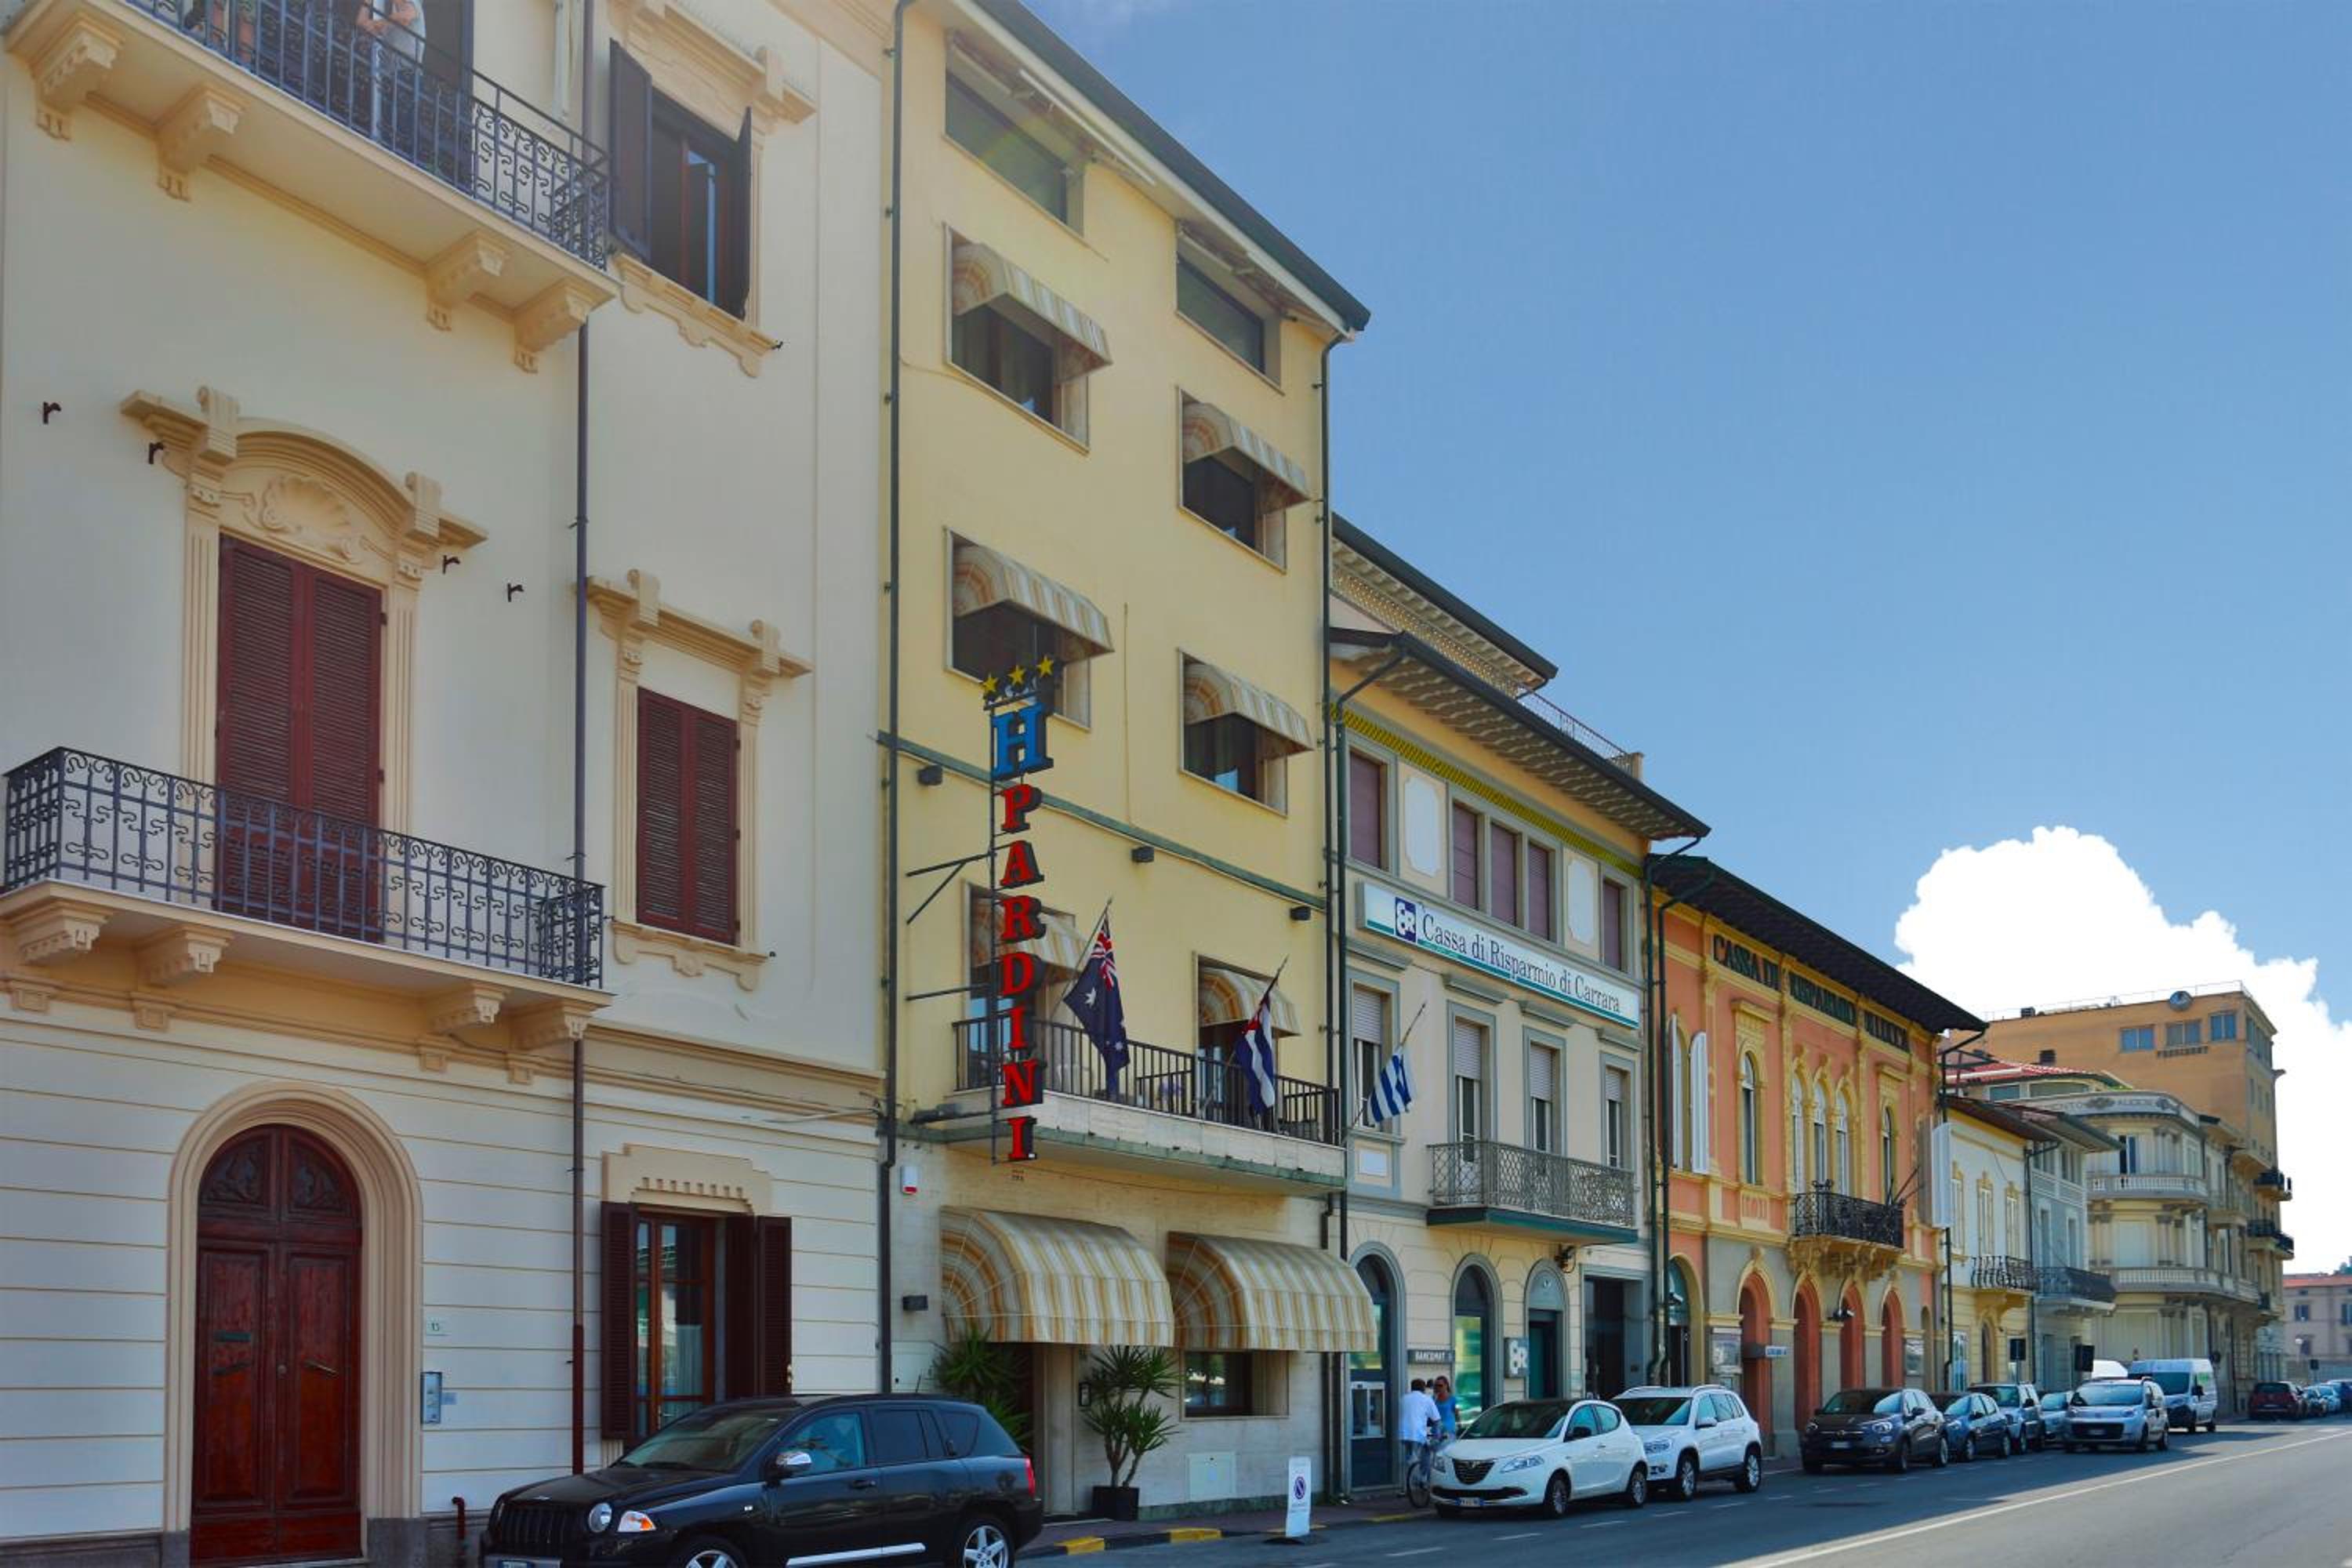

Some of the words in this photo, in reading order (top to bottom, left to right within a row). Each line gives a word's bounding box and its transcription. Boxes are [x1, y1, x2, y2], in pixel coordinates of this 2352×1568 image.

[990, 702, 1052, 780] H
[1000, 783, 1044, 1160] PARDINI
[1423, 913, 1467, 955] Cassa
[1472, 934, 1485, 962] di
[1490, 940, 1556, 989] Risparmio
[1559, 969, 1571, 995] di
[1575, 975, 1621, 1012] Carrara
[1713, 935, 1759, 982] CASSA
